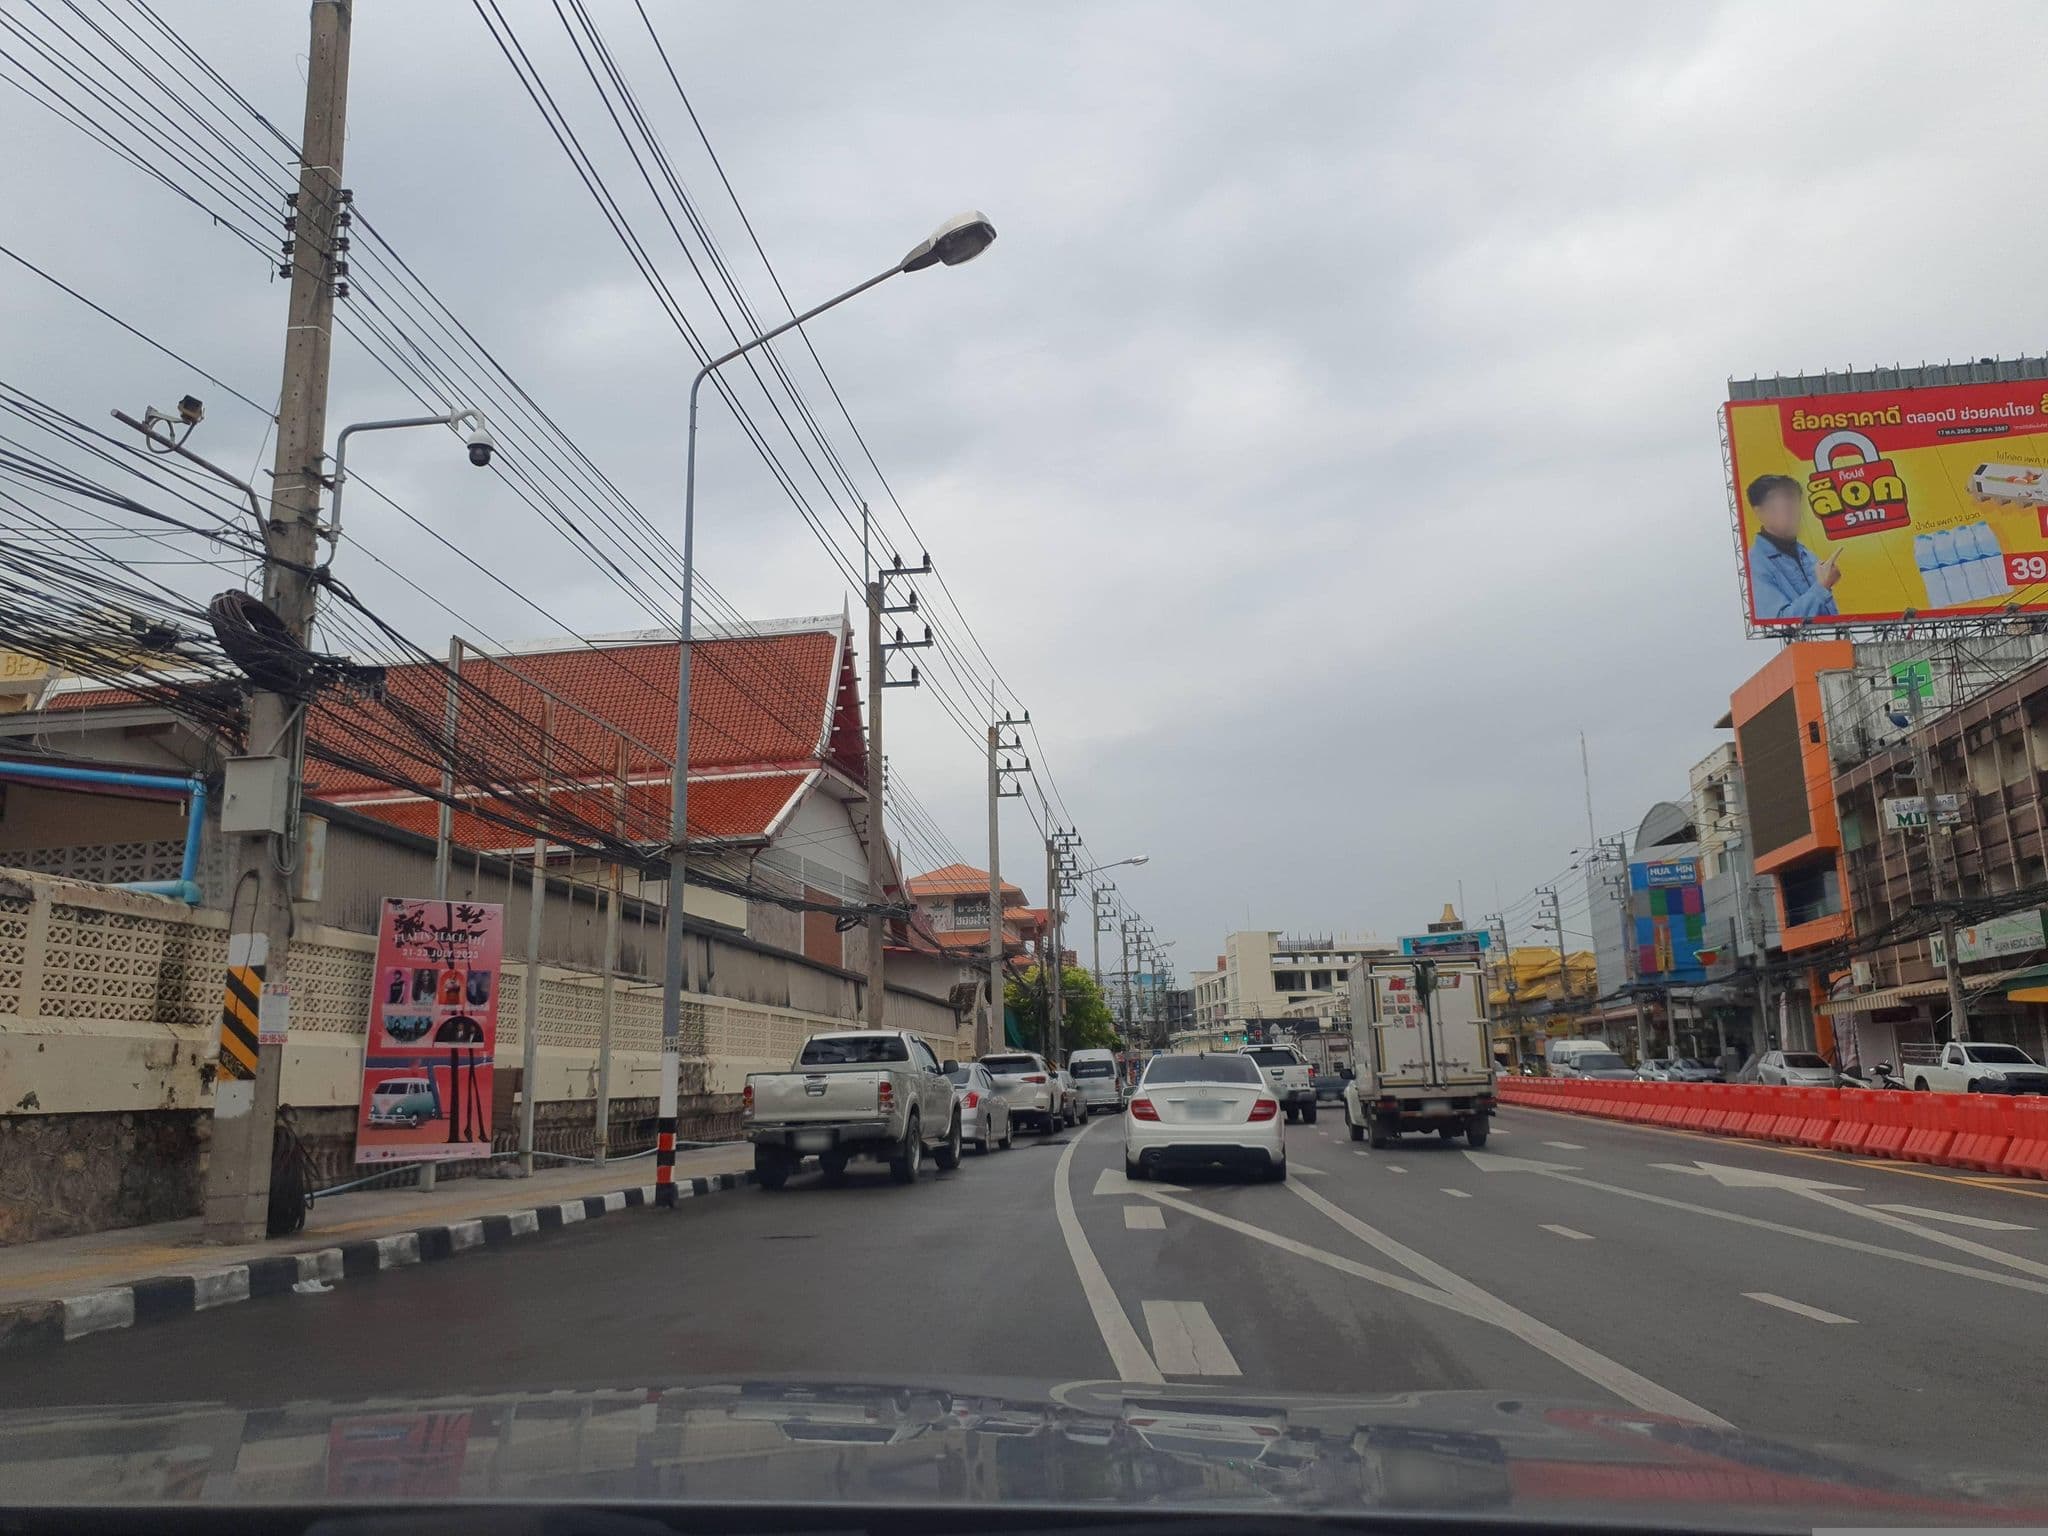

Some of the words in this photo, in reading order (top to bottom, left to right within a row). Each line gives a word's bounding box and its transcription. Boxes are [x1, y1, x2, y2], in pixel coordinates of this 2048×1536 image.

[1791, 405, 1902, 431] ล็อคราคาดี
[1906, 408, 1956, 424] ตลอดปี
[1960, 401, 2035, 420] ช่วยคนไทย
[1844, 508, 1886, 526] ราคา
[2011, 556, 2047, 580] 39
[1650, 867, 1671, 876] HUA
[1675, 864, 1693, 873] HIN
